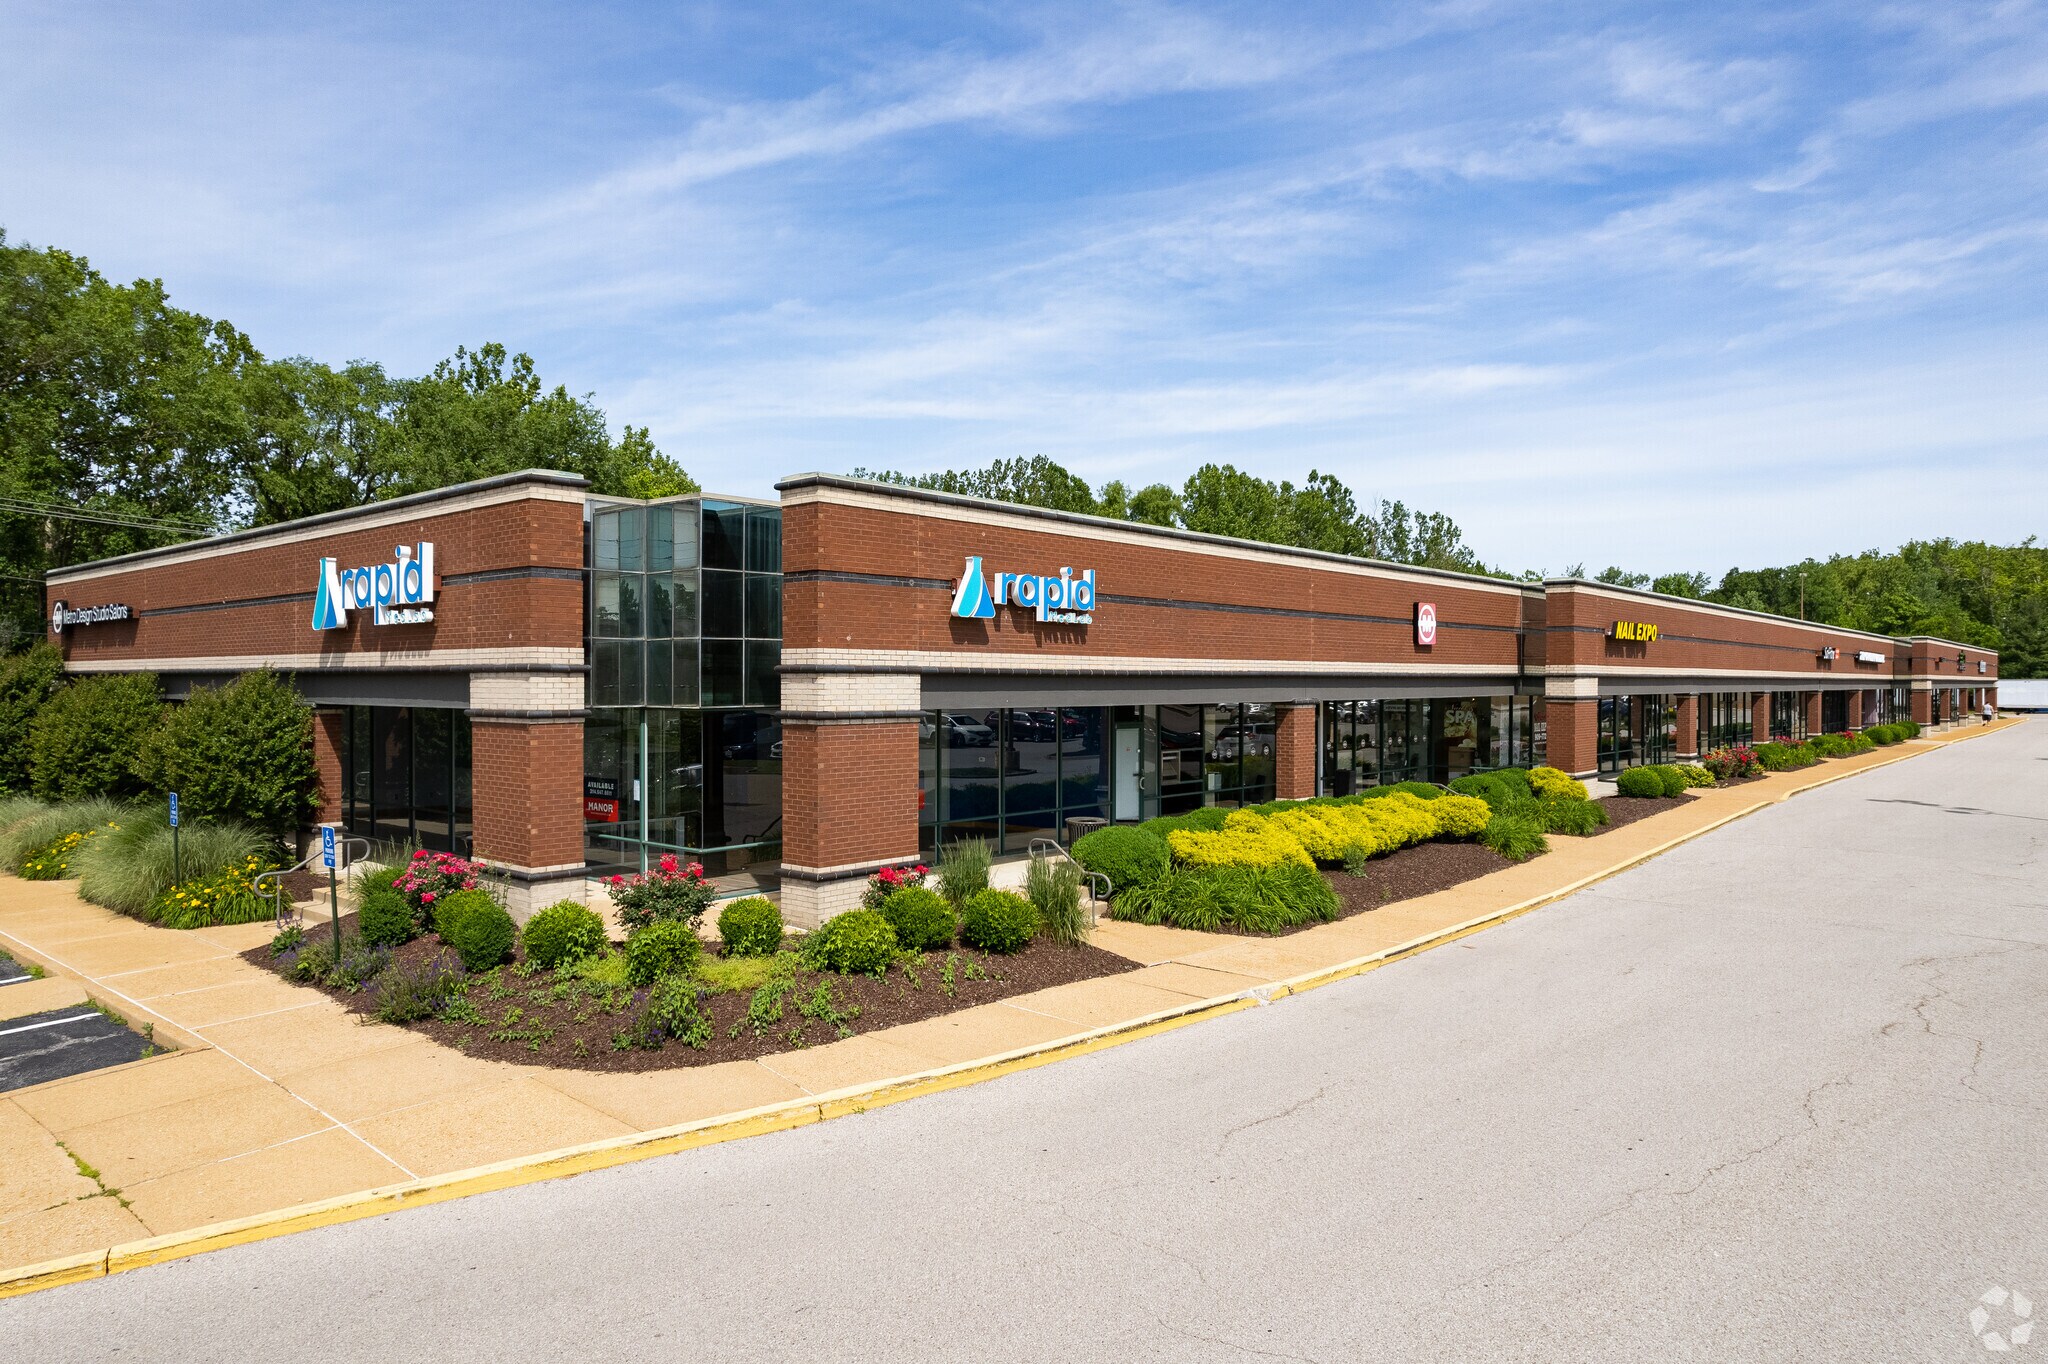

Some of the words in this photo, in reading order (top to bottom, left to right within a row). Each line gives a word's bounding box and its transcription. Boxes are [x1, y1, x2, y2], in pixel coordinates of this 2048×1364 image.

[341, 542, 433, 625] rapid
[995, 567, 1095, 622] rapid
[63, 609, 75, 624] Metro
[76, 608, 93, 626] Design
[93, 605, 109, 622] Studio
[109, 603, 128, 620] Salons
[1615, 621, 1635, 640] NAIL
[1636, 623, 1658, 642] EXPO
[1445, 709, 1475, 724] SPA
[587, 781, 614, 790] AVAILABLE
[588, 801, 614, 813] MANOR
